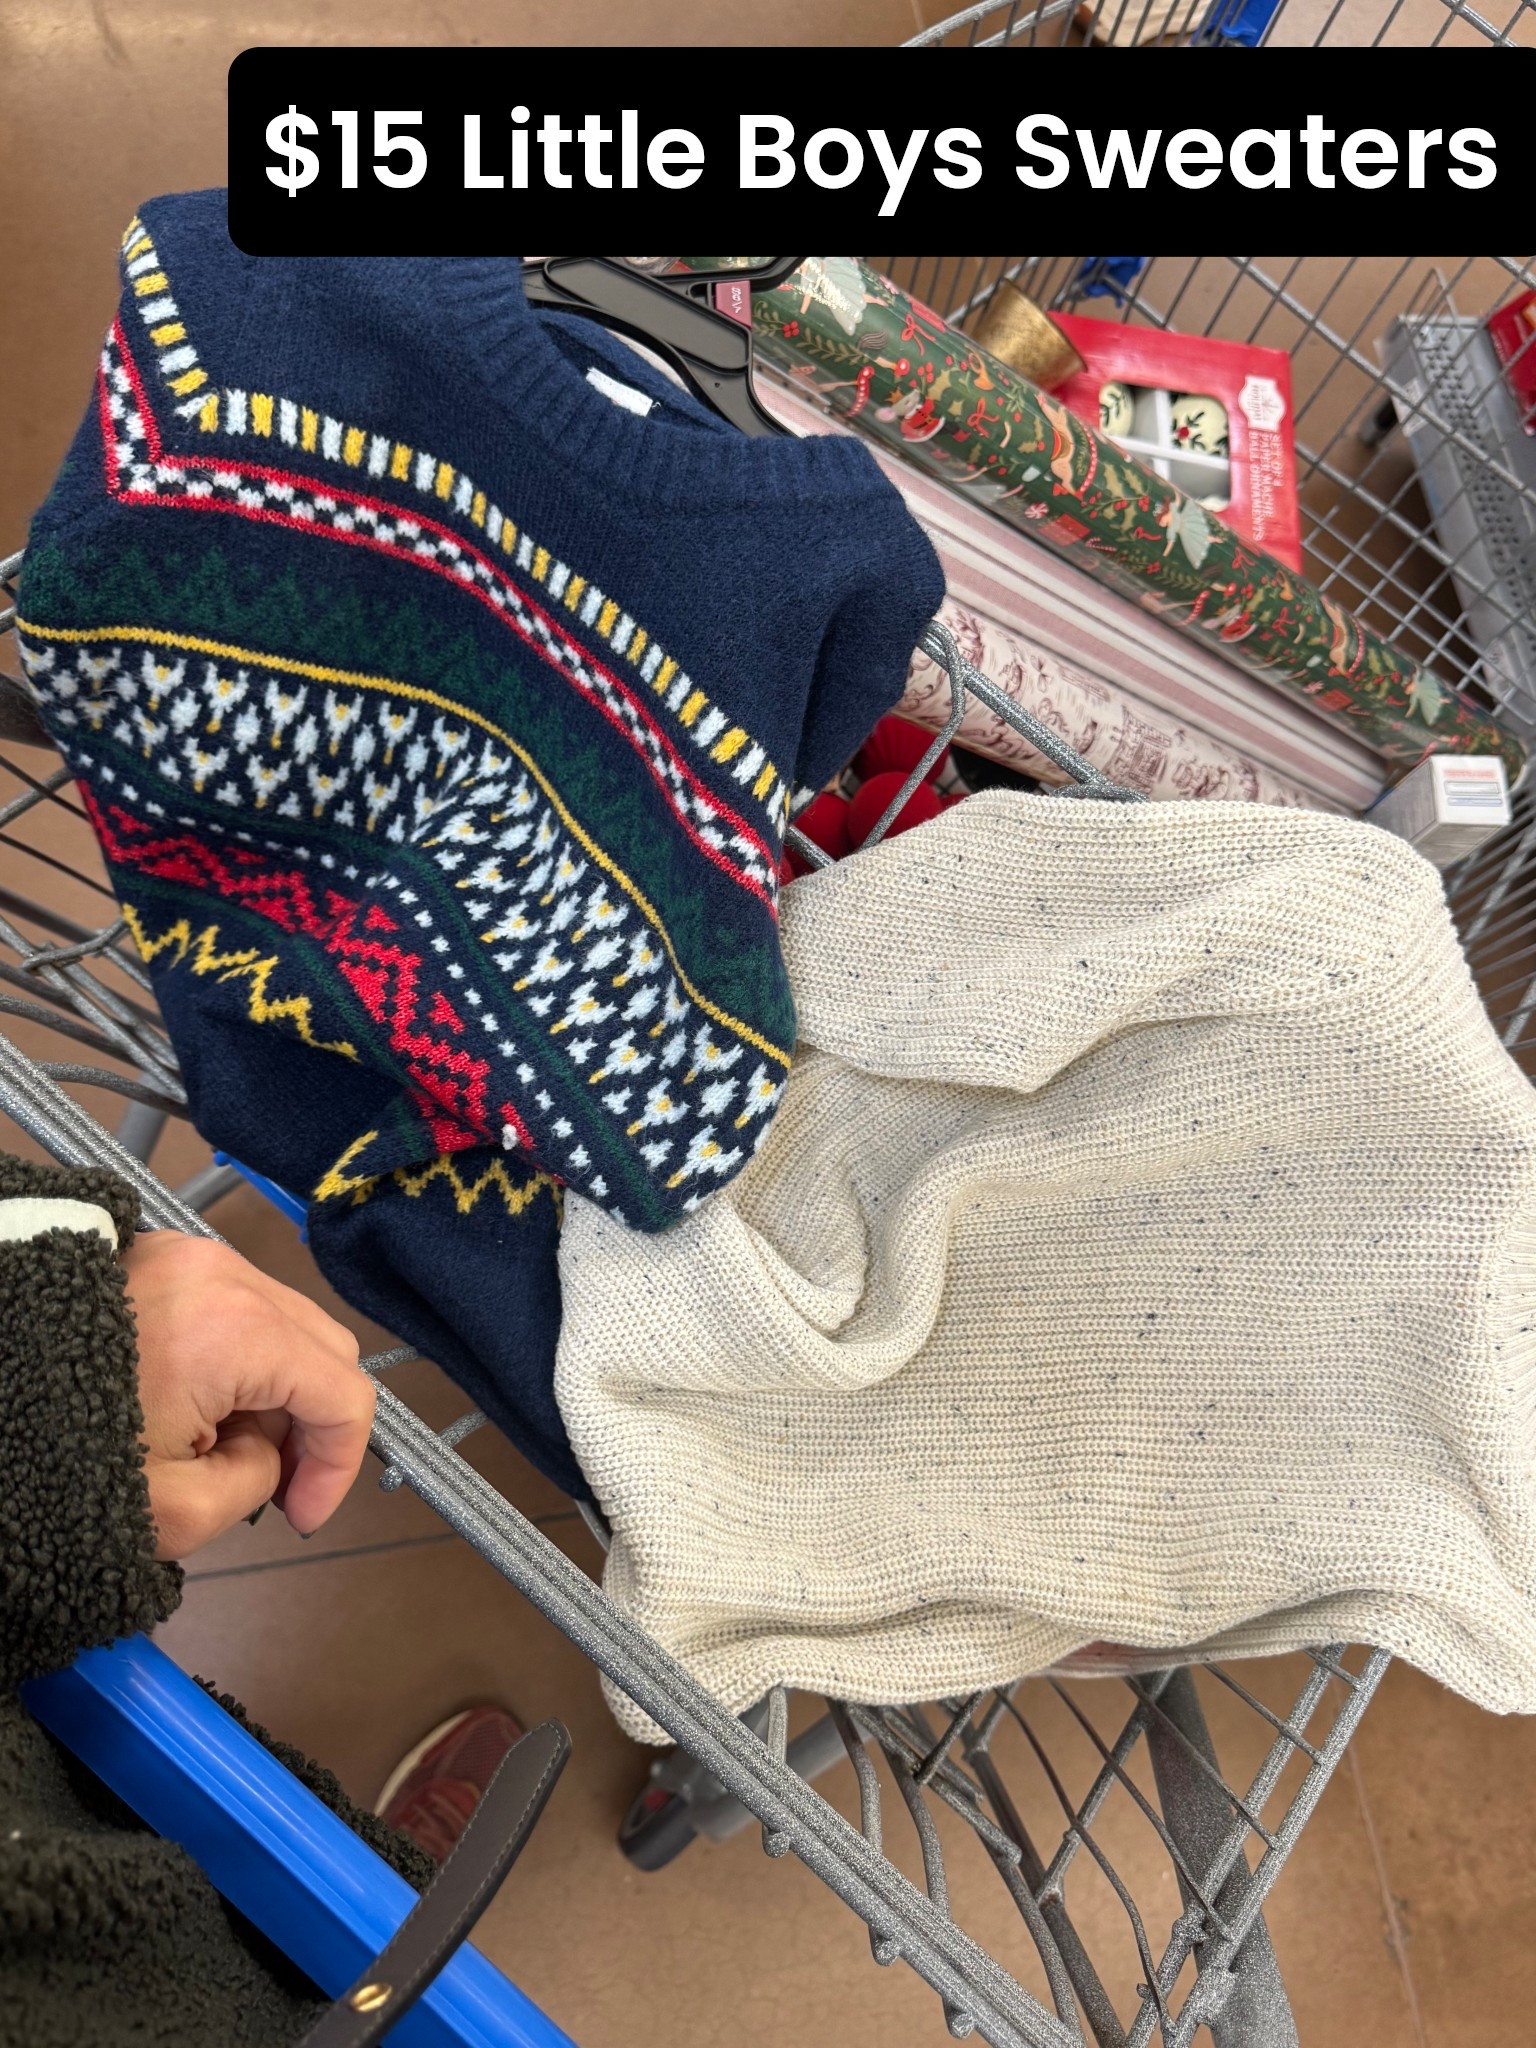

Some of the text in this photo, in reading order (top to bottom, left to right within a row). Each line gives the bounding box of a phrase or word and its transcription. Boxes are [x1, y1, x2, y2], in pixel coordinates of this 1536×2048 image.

[1249, 431, 1261, 460] BALL
[1260, 432, 1272, 472] PAPER
[1270, 433, 1282, 457] SET
[1270, 461, 1283, 476] OF
[1249, 463, 1265, 541] ORNAMENTS
